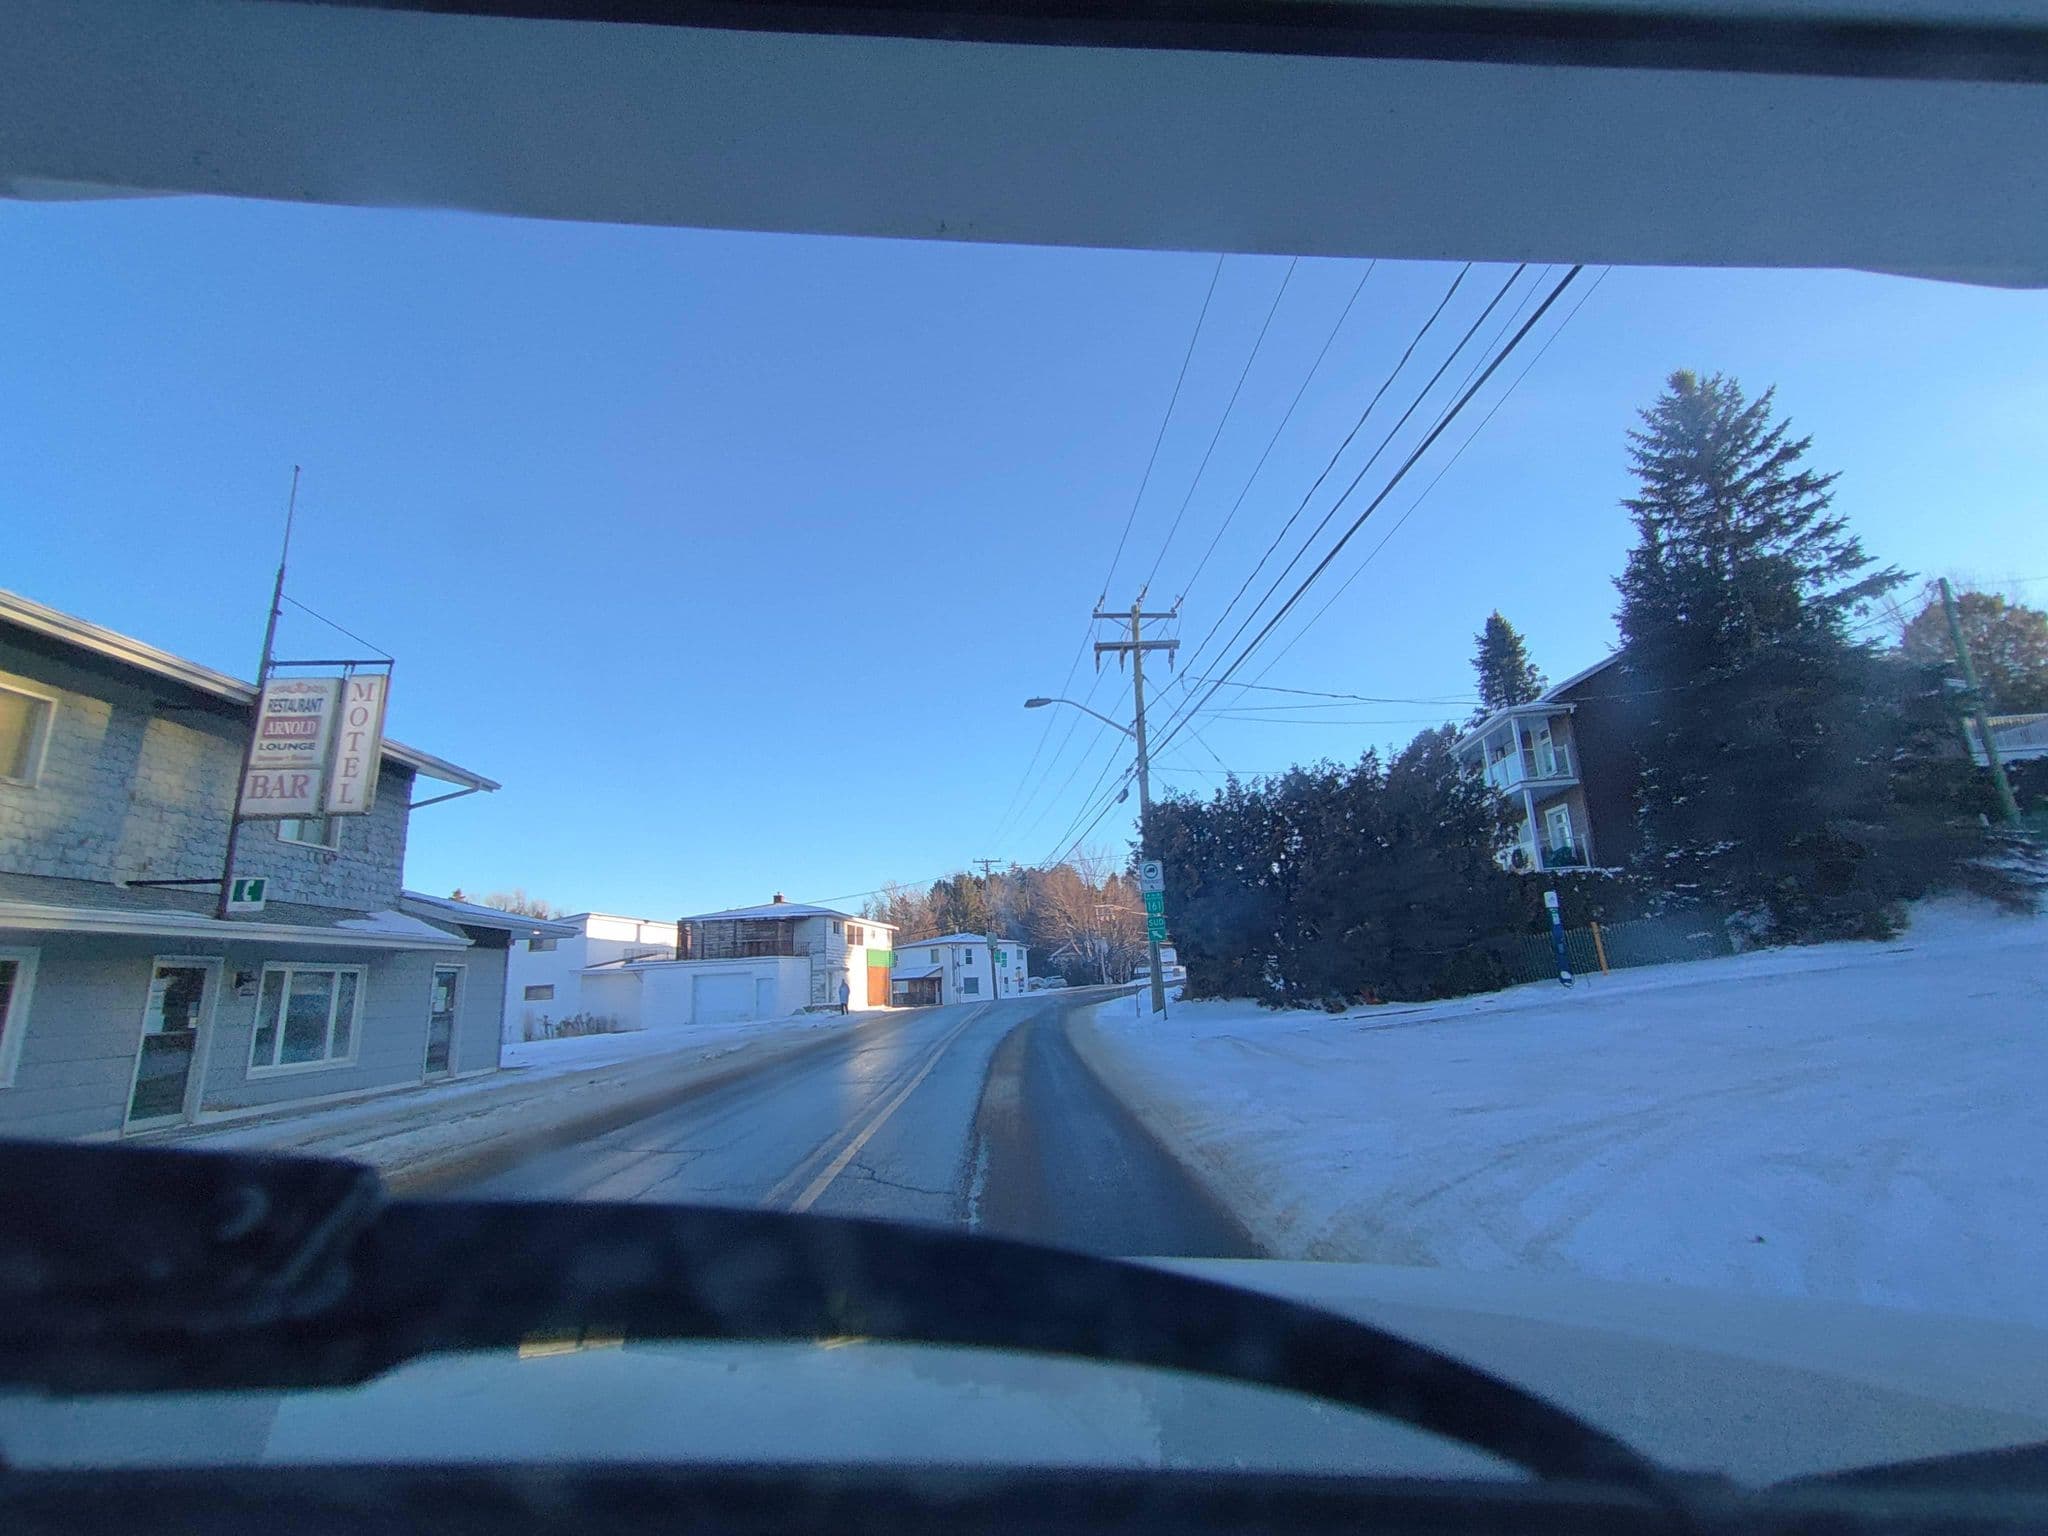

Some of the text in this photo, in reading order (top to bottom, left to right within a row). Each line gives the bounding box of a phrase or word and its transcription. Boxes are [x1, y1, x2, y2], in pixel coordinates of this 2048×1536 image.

[269, 698, 324, 713] RESTAURANT
[264, 721, 316, 735] ARNOLD
[259, 742, 316, 751] LOUNGE
[338, 683, 375, 805] MOTEL
[248, 775, 311, 799] BAR
[1148, 901, 1161, 911] 161
[1148, 918, 1164, 927] SUD
